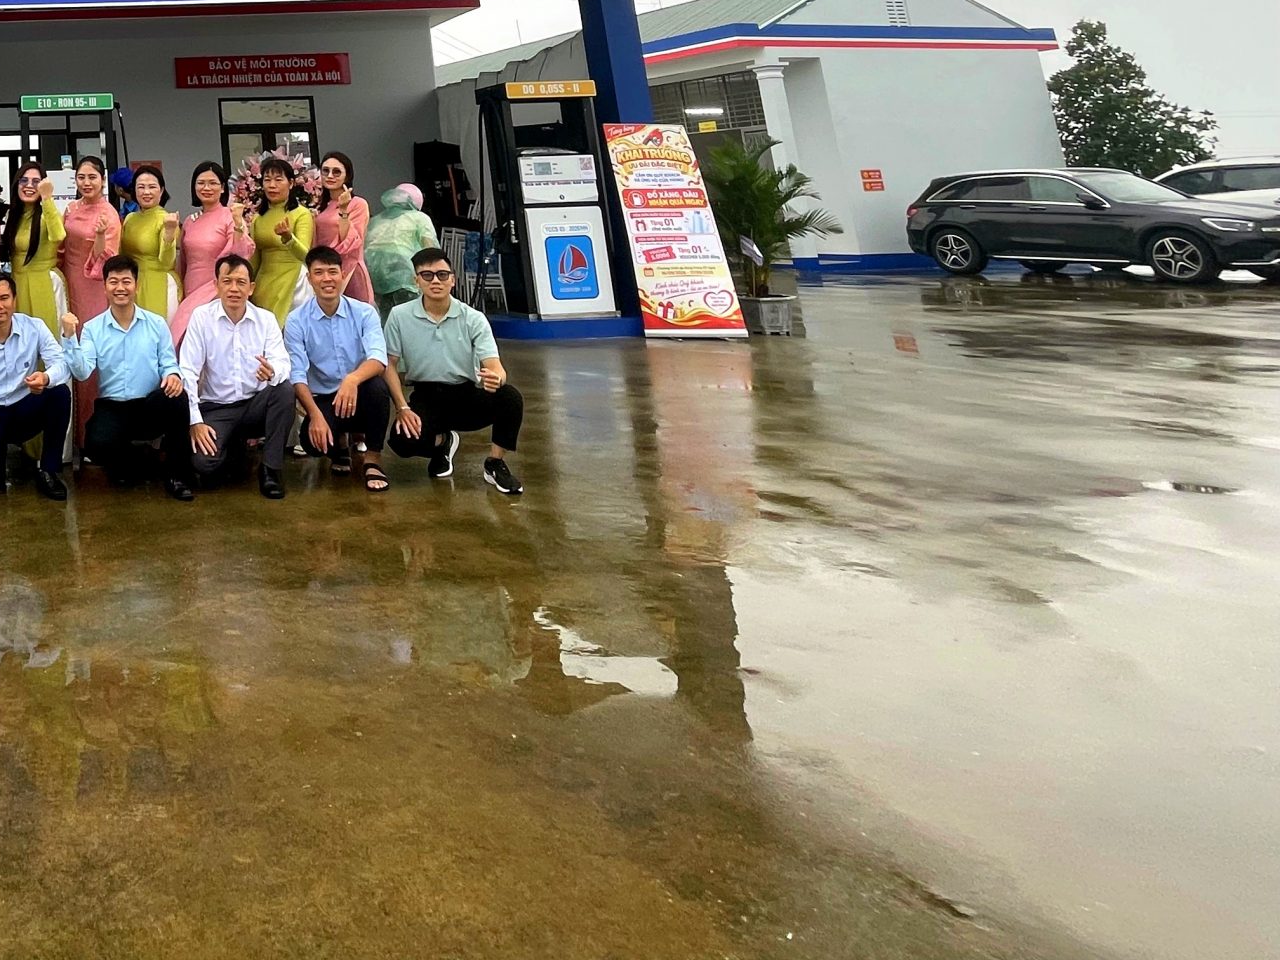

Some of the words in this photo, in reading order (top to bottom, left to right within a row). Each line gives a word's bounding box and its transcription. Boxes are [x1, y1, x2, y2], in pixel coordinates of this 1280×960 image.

[209, 57, 231, 70] BẢO
[234, 58, 247, 72] VỆ
[250, 58, 270, 69] MÔI
[273, 56, 317, 68] TRƯỜNG
[201, 73, 230, 85] TRÁCH
[232, 72, 262, 85] NHIỆM
[264, 70, 283, 82] CỦA
[325, 70, 340, 82] HỘI
[523, 85, 534, 94] DO
[38, 98, 51, 108] E10
[58, 97, 73, 107] RON
[616, 148, 642, 163] KHAI
